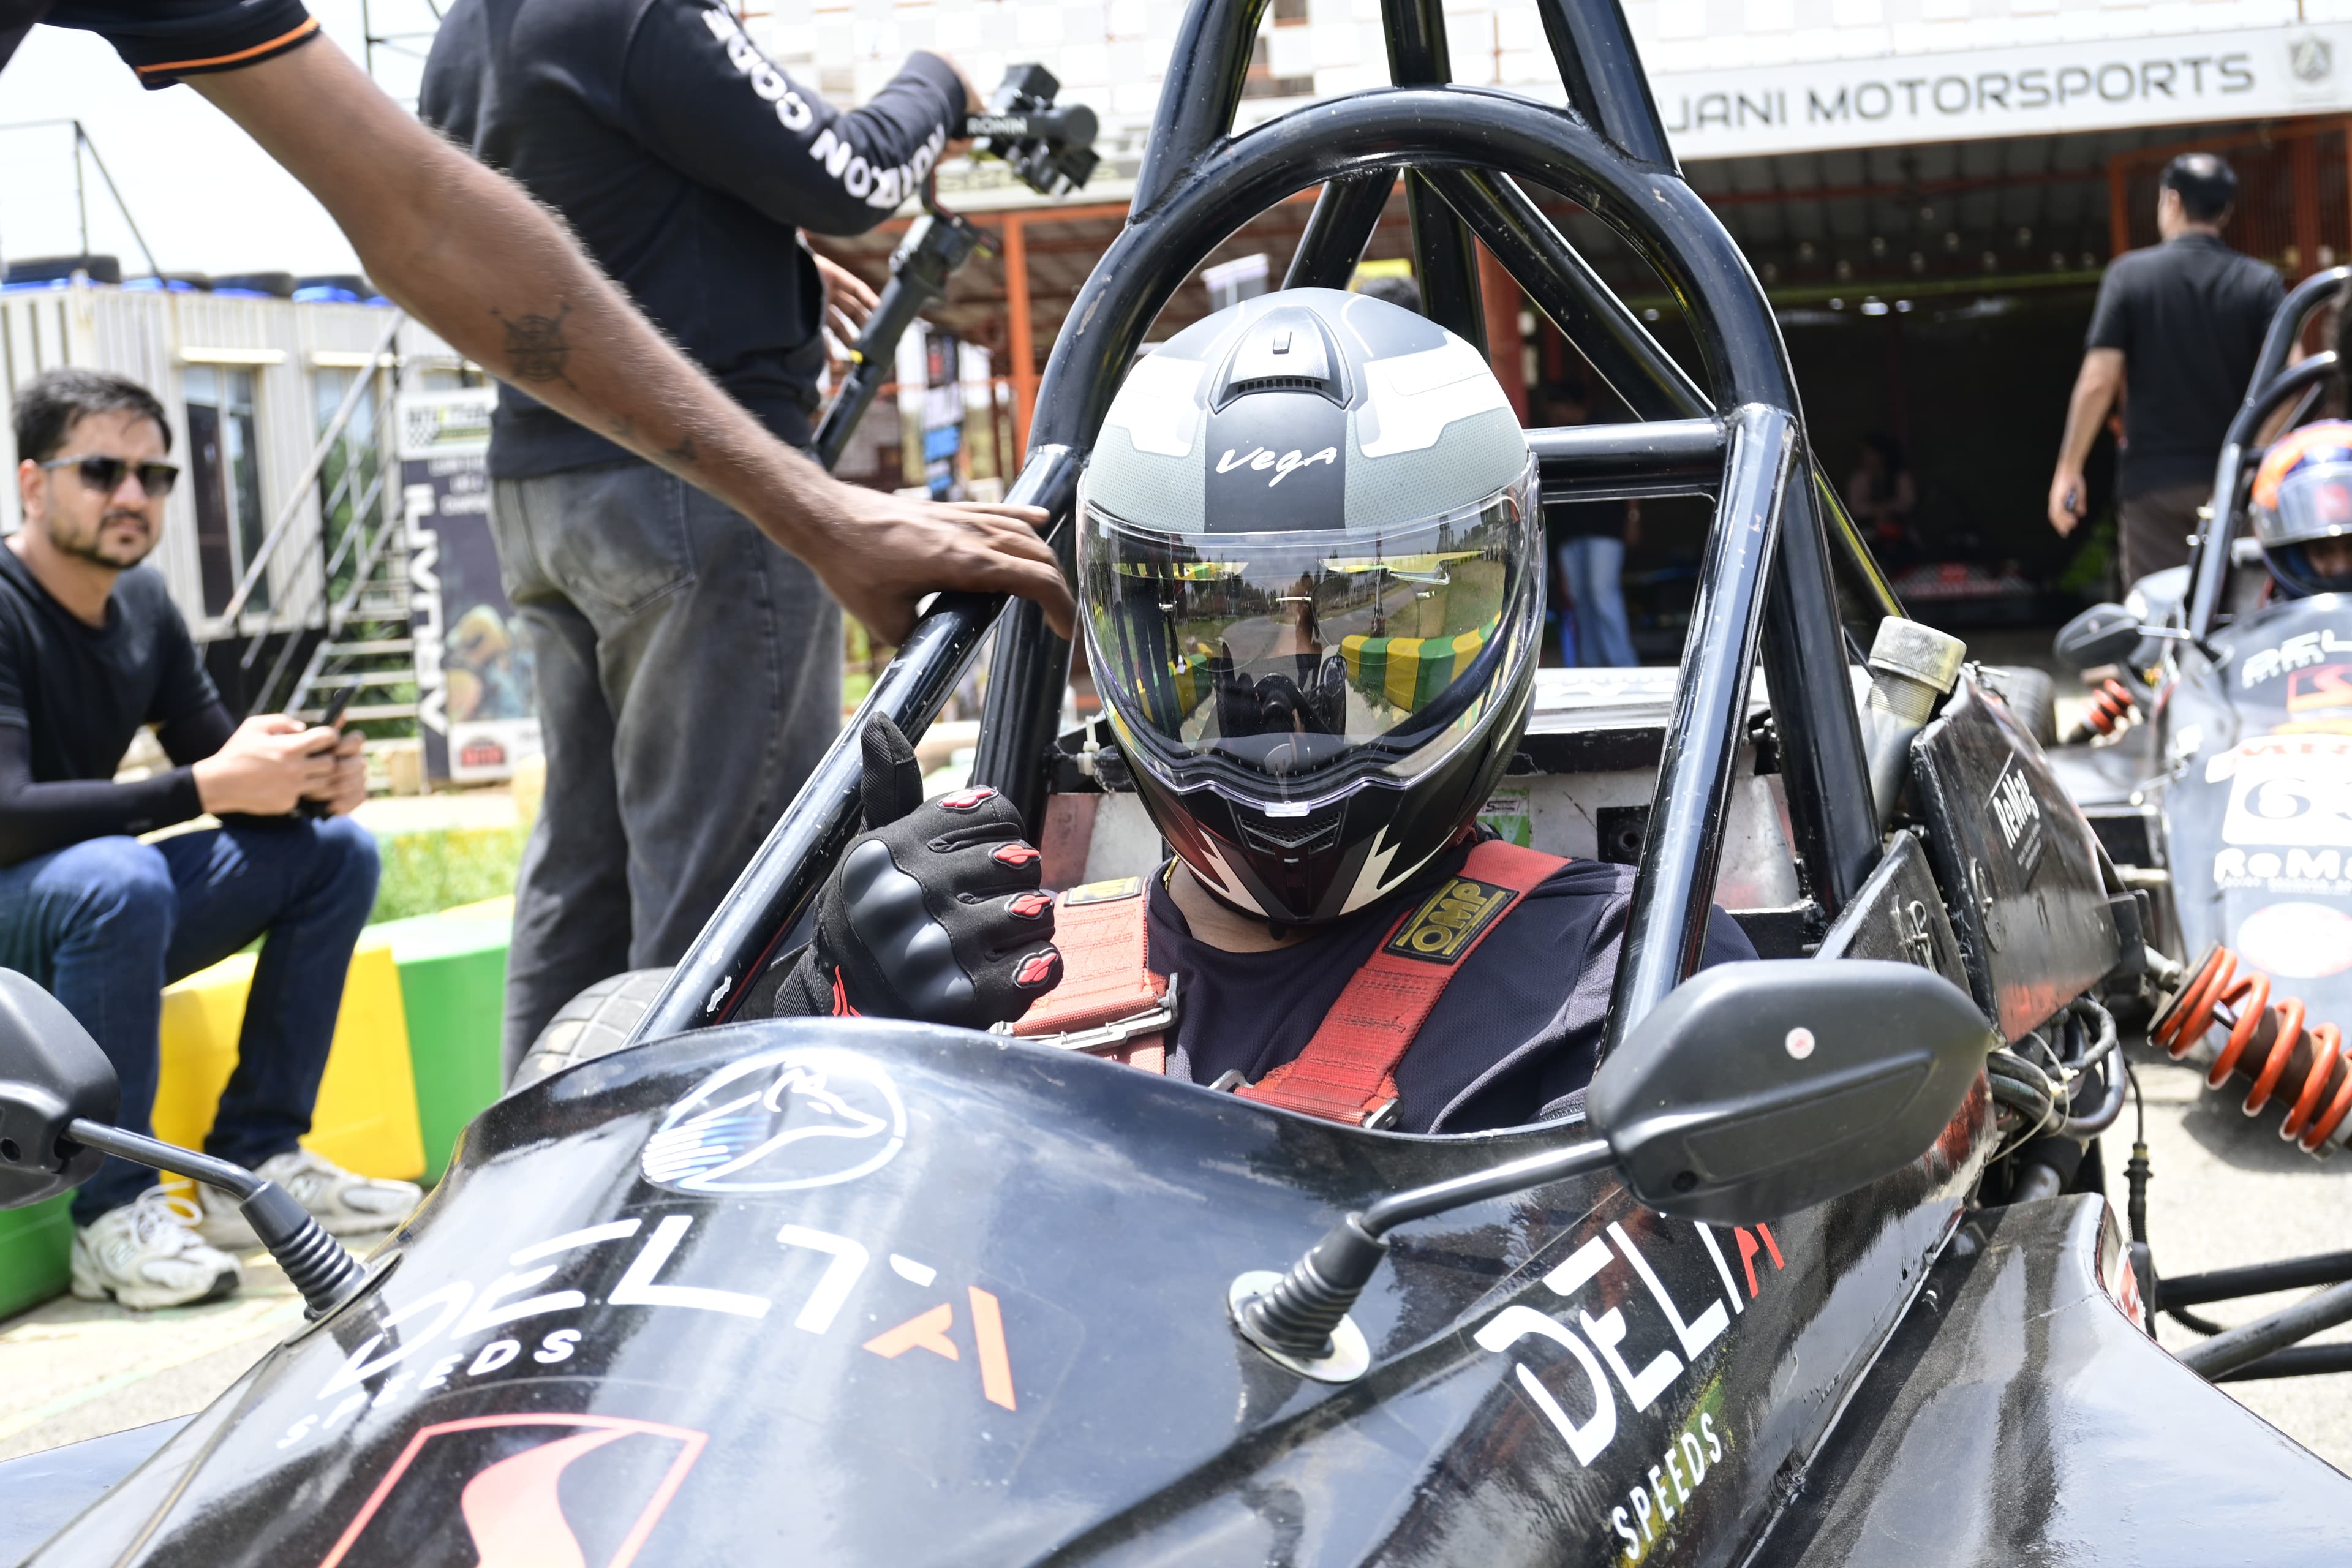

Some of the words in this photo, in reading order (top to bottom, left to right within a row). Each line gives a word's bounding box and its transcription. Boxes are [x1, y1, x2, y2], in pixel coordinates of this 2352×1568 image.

[1807, 53, 2255, 124] MOTORSPORTS
[1412, 883, 1487, 952] OMP
[317, 1215, 1016, 1411] DELTA
[277, 1329, 582, 1449] SPEEDS
[1611, 1412, 1722, 1561] SPEEDS
